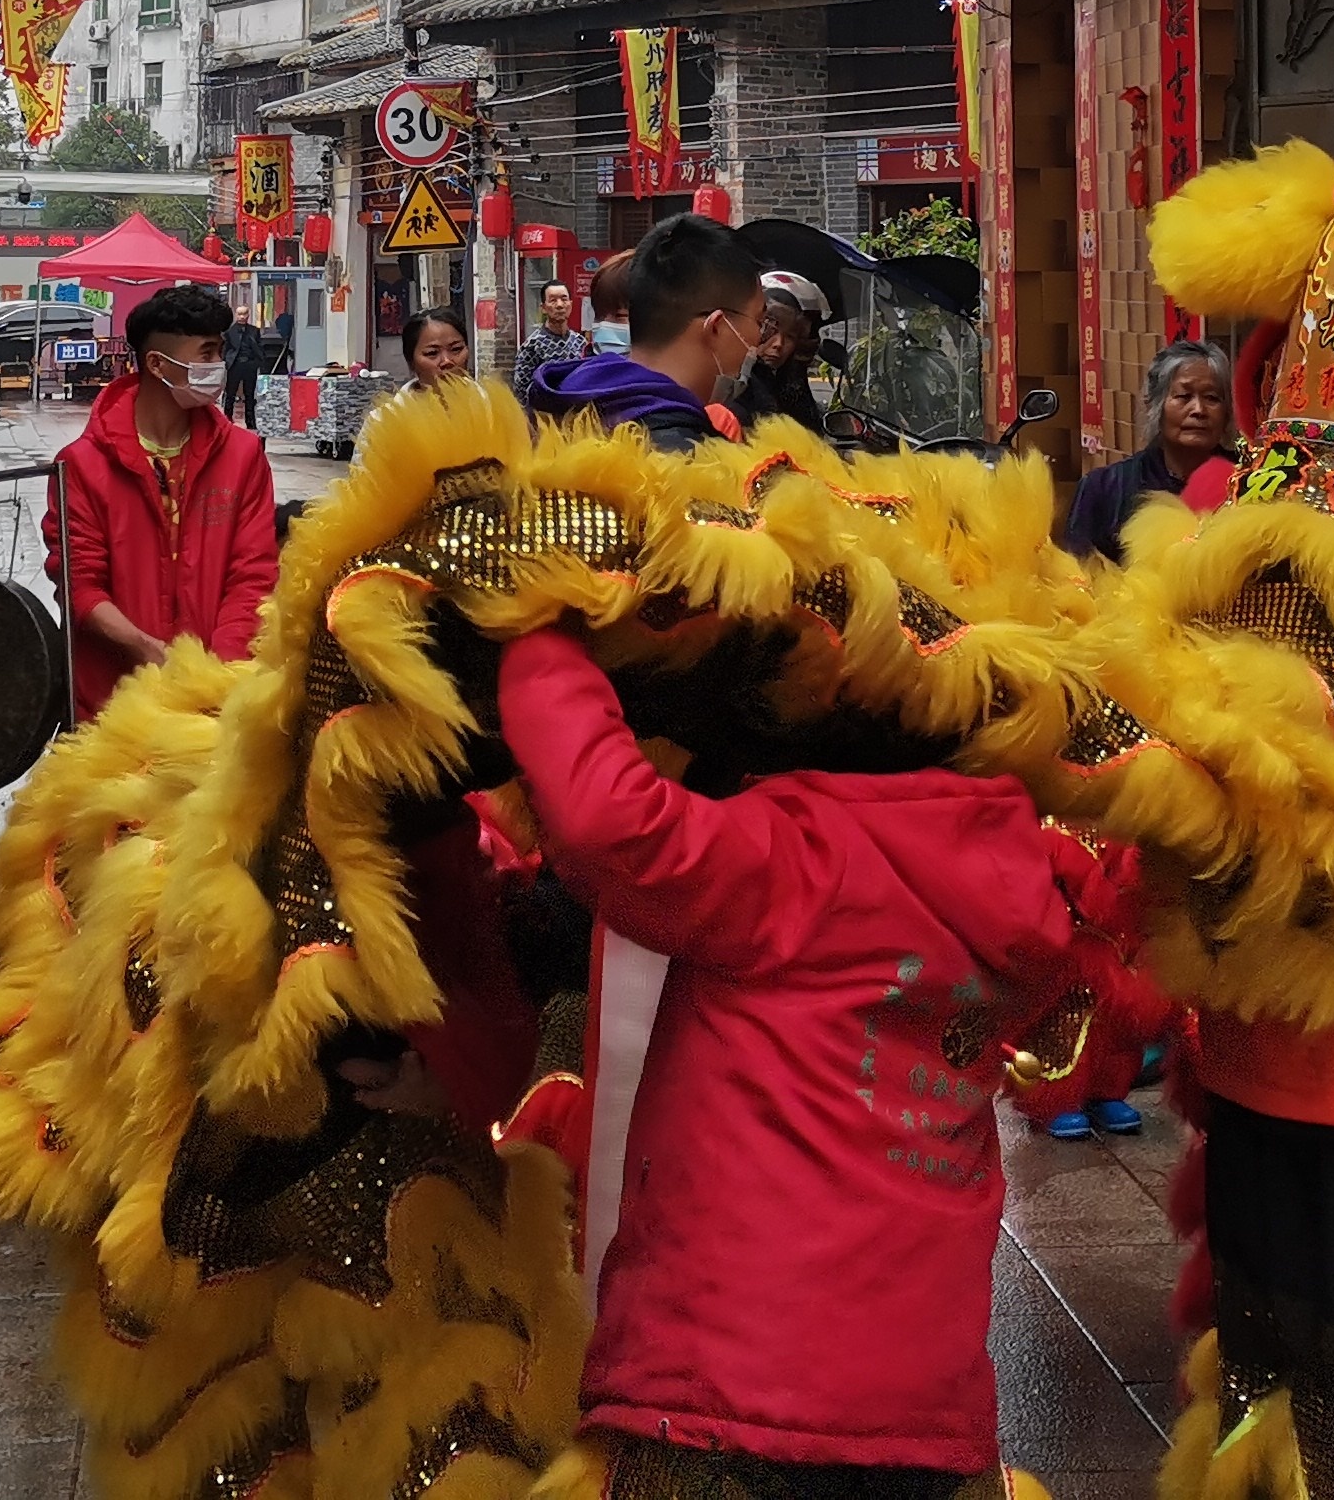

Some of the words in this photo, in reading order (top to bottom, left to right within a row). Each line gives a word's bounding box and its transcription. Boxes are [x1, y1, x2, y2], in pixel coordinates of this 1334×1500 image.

[391, 106, 443, 145] 30
[250, 160, 281, 195] 酒
[62, 344, 91, 358] 出口
